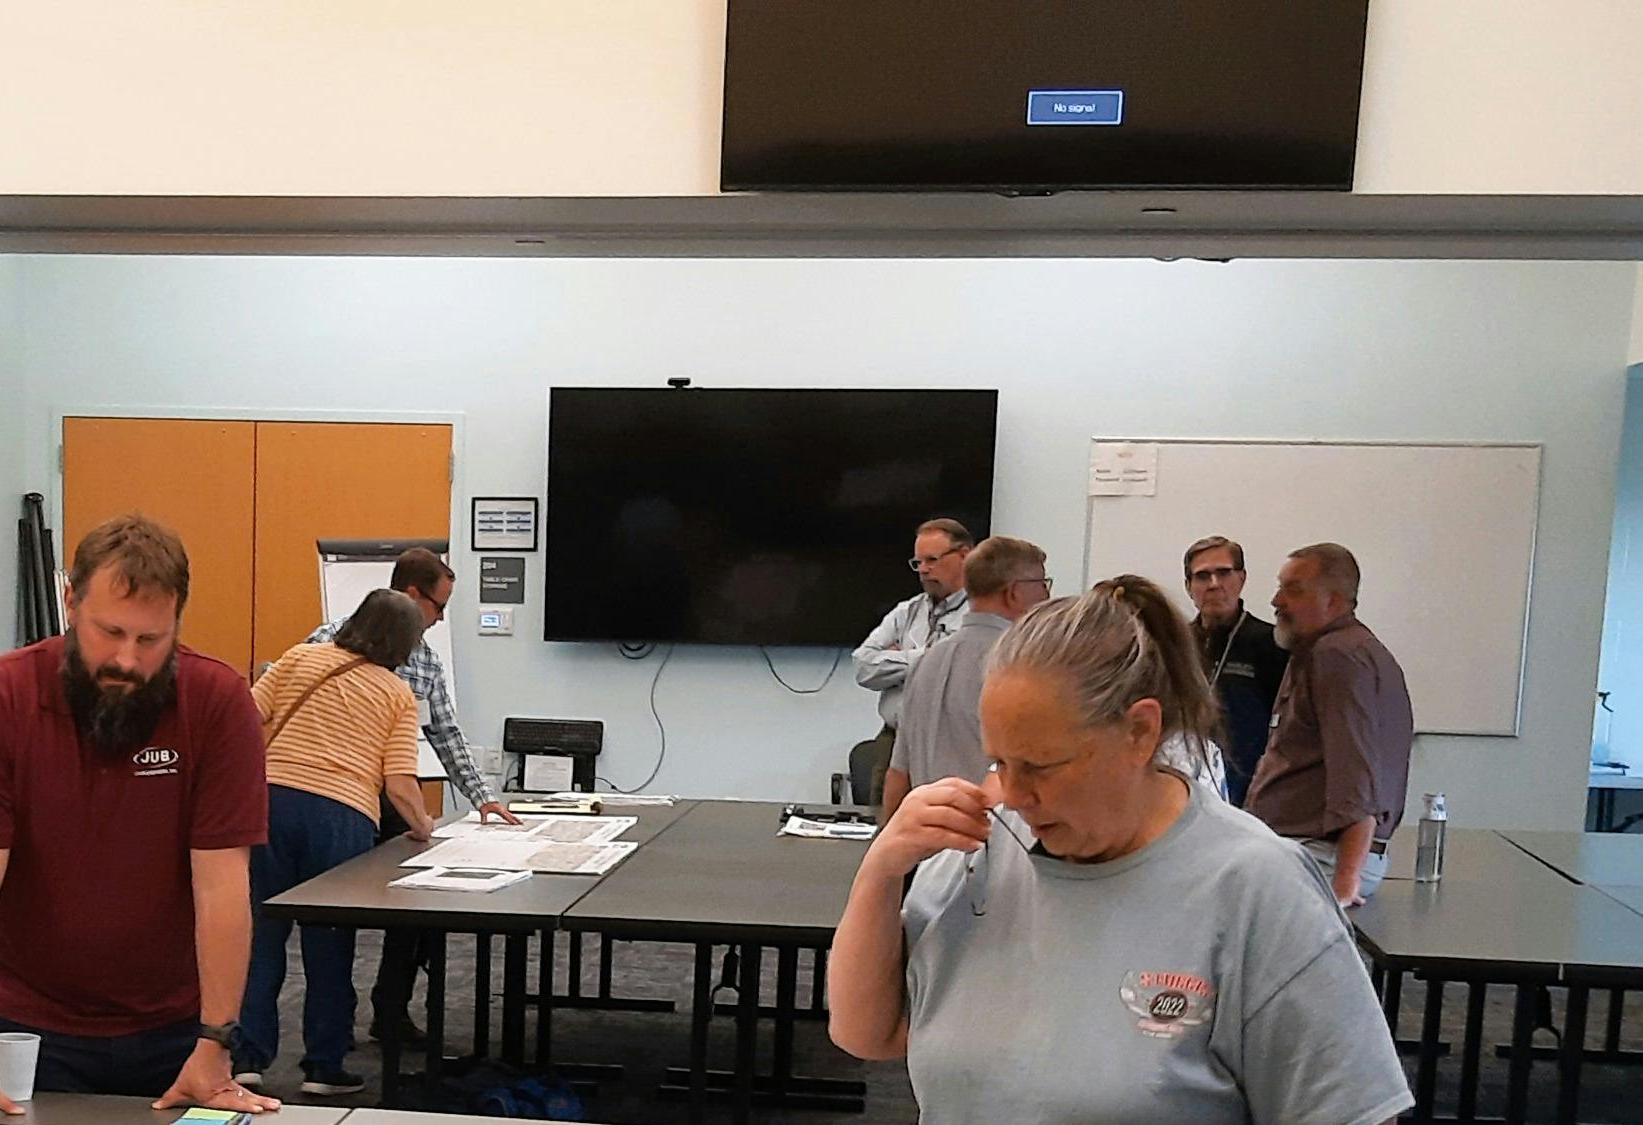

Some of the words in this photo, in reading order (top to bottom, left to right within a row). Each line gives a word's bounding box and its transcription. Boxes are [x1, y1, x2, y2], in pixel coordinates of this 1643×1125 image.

[1053, 103, 1067, 113] No
[1067, 103, 1096, 114] signal
[139, 749, 171, 764] JUB
[1152, 995, 1186, 1016] 2022
